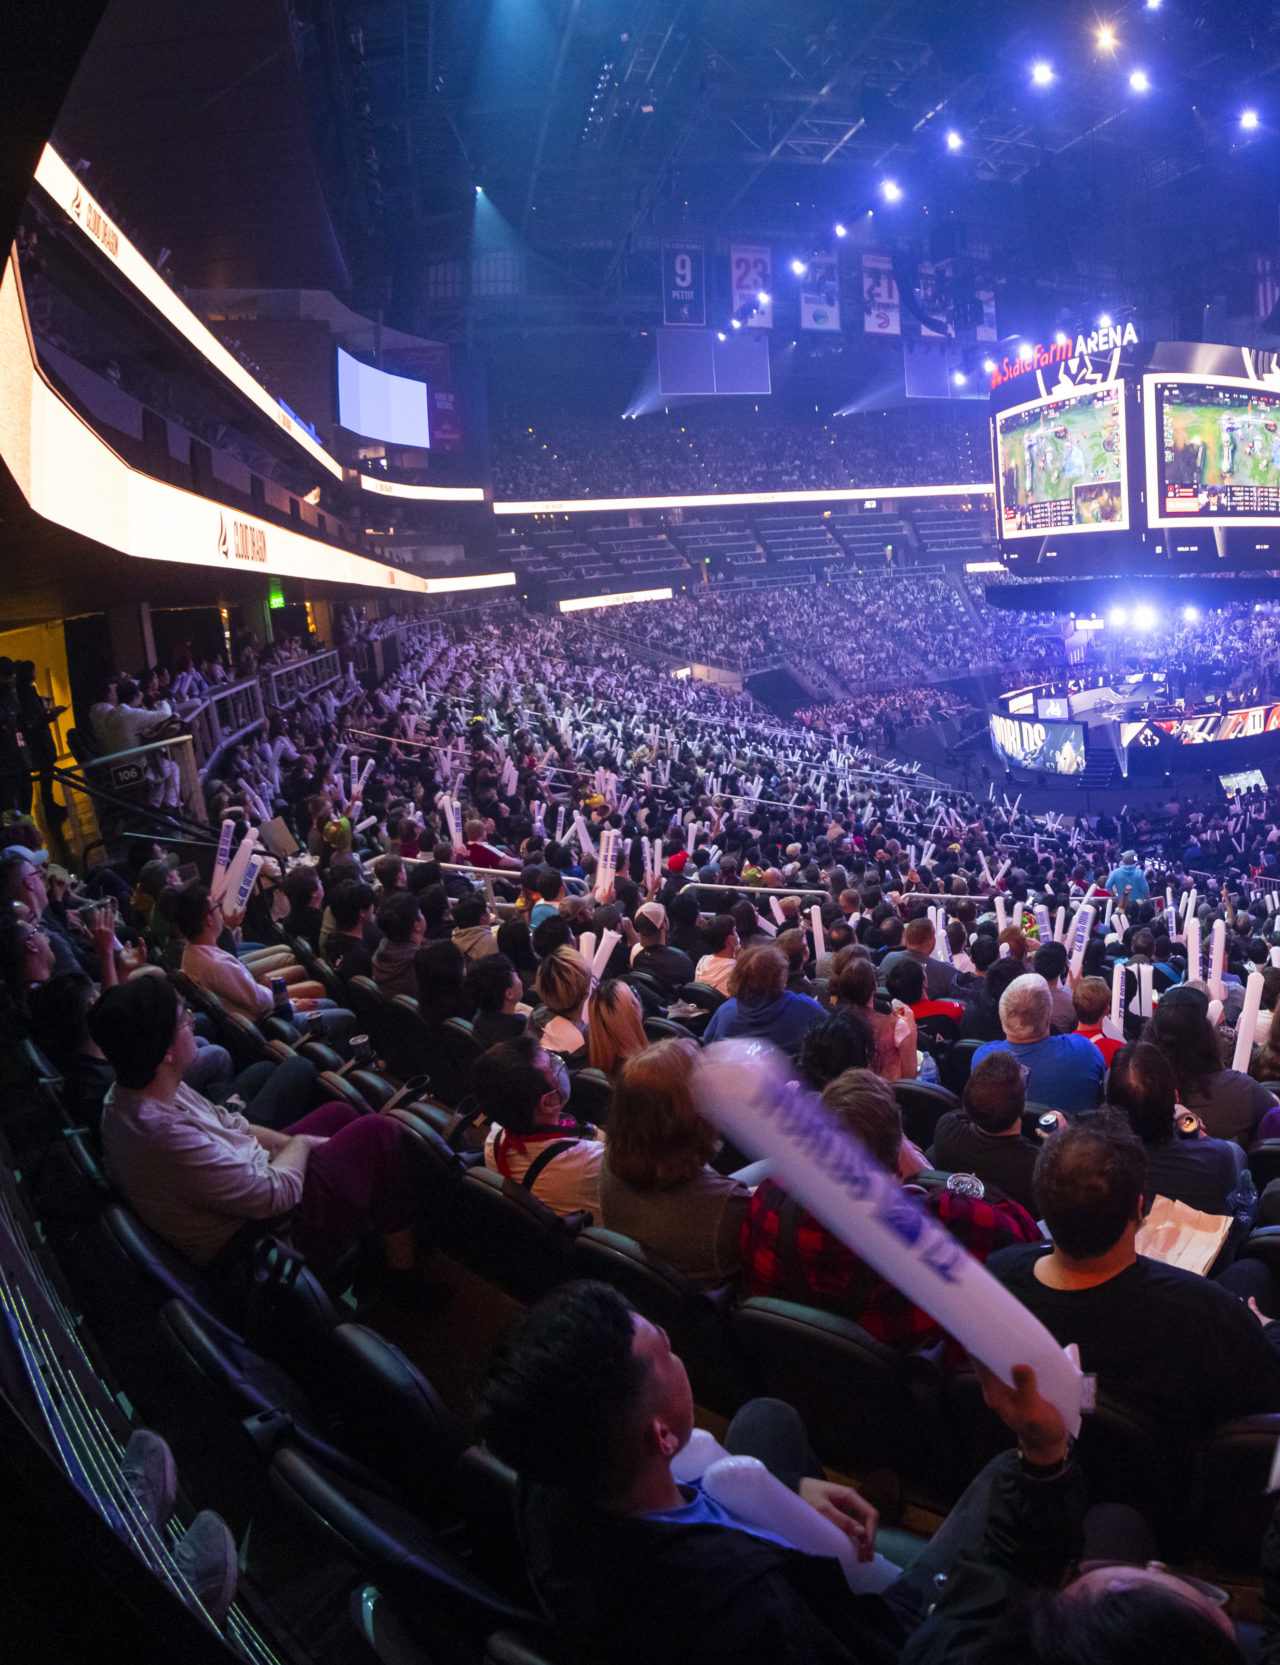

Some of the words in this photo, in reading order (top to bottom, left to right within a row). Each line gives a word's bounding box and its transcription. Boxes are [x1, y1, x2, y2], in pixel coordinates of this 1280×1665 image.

[675, 254, 692, 287] 9
[1033, 339, 1073, 370] Farm
[1075, 322, 1138, 357] ARENA
[991, 713, 1046, 757] WORLDS
